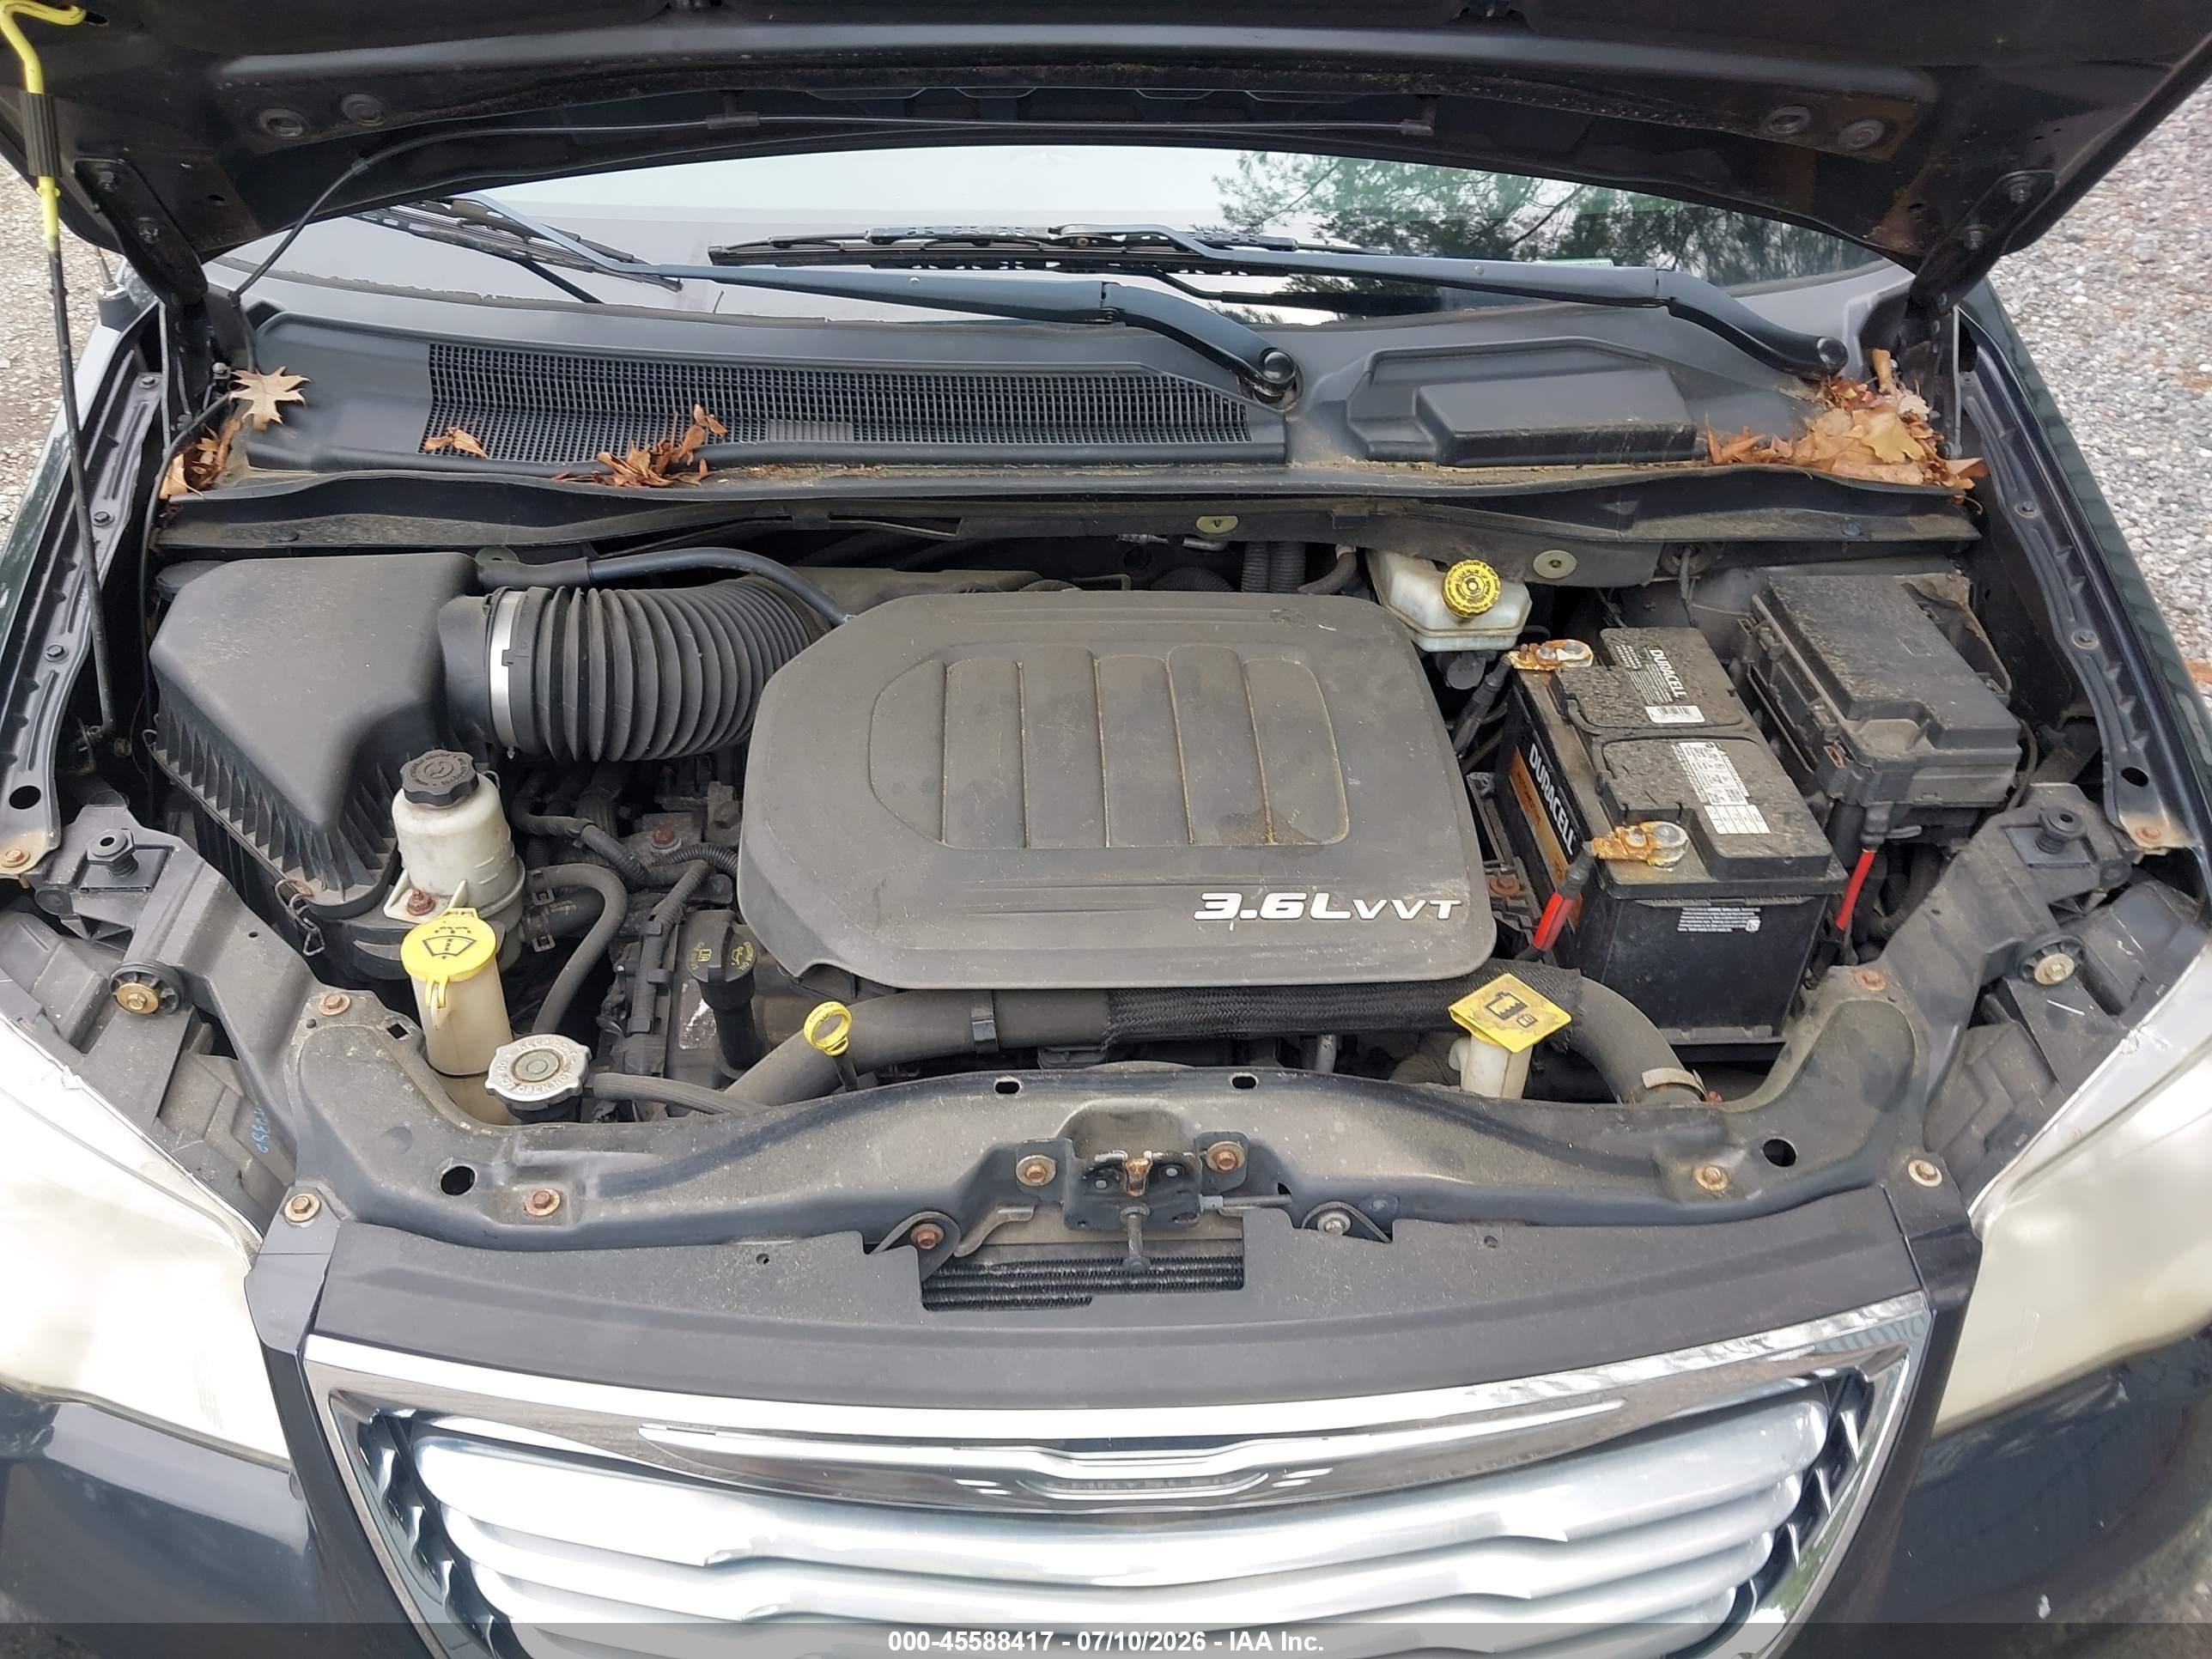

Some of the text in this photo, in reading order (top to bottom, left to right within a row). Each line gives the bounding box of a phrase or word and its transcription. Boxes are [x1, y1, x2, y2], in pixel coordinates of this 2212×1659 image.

[1649, 649, 1687, 698] DURACELL
[1529, 743, 1573, 856] DURACELL
[1194, 892, 1462, 921] 3.6L VVT
